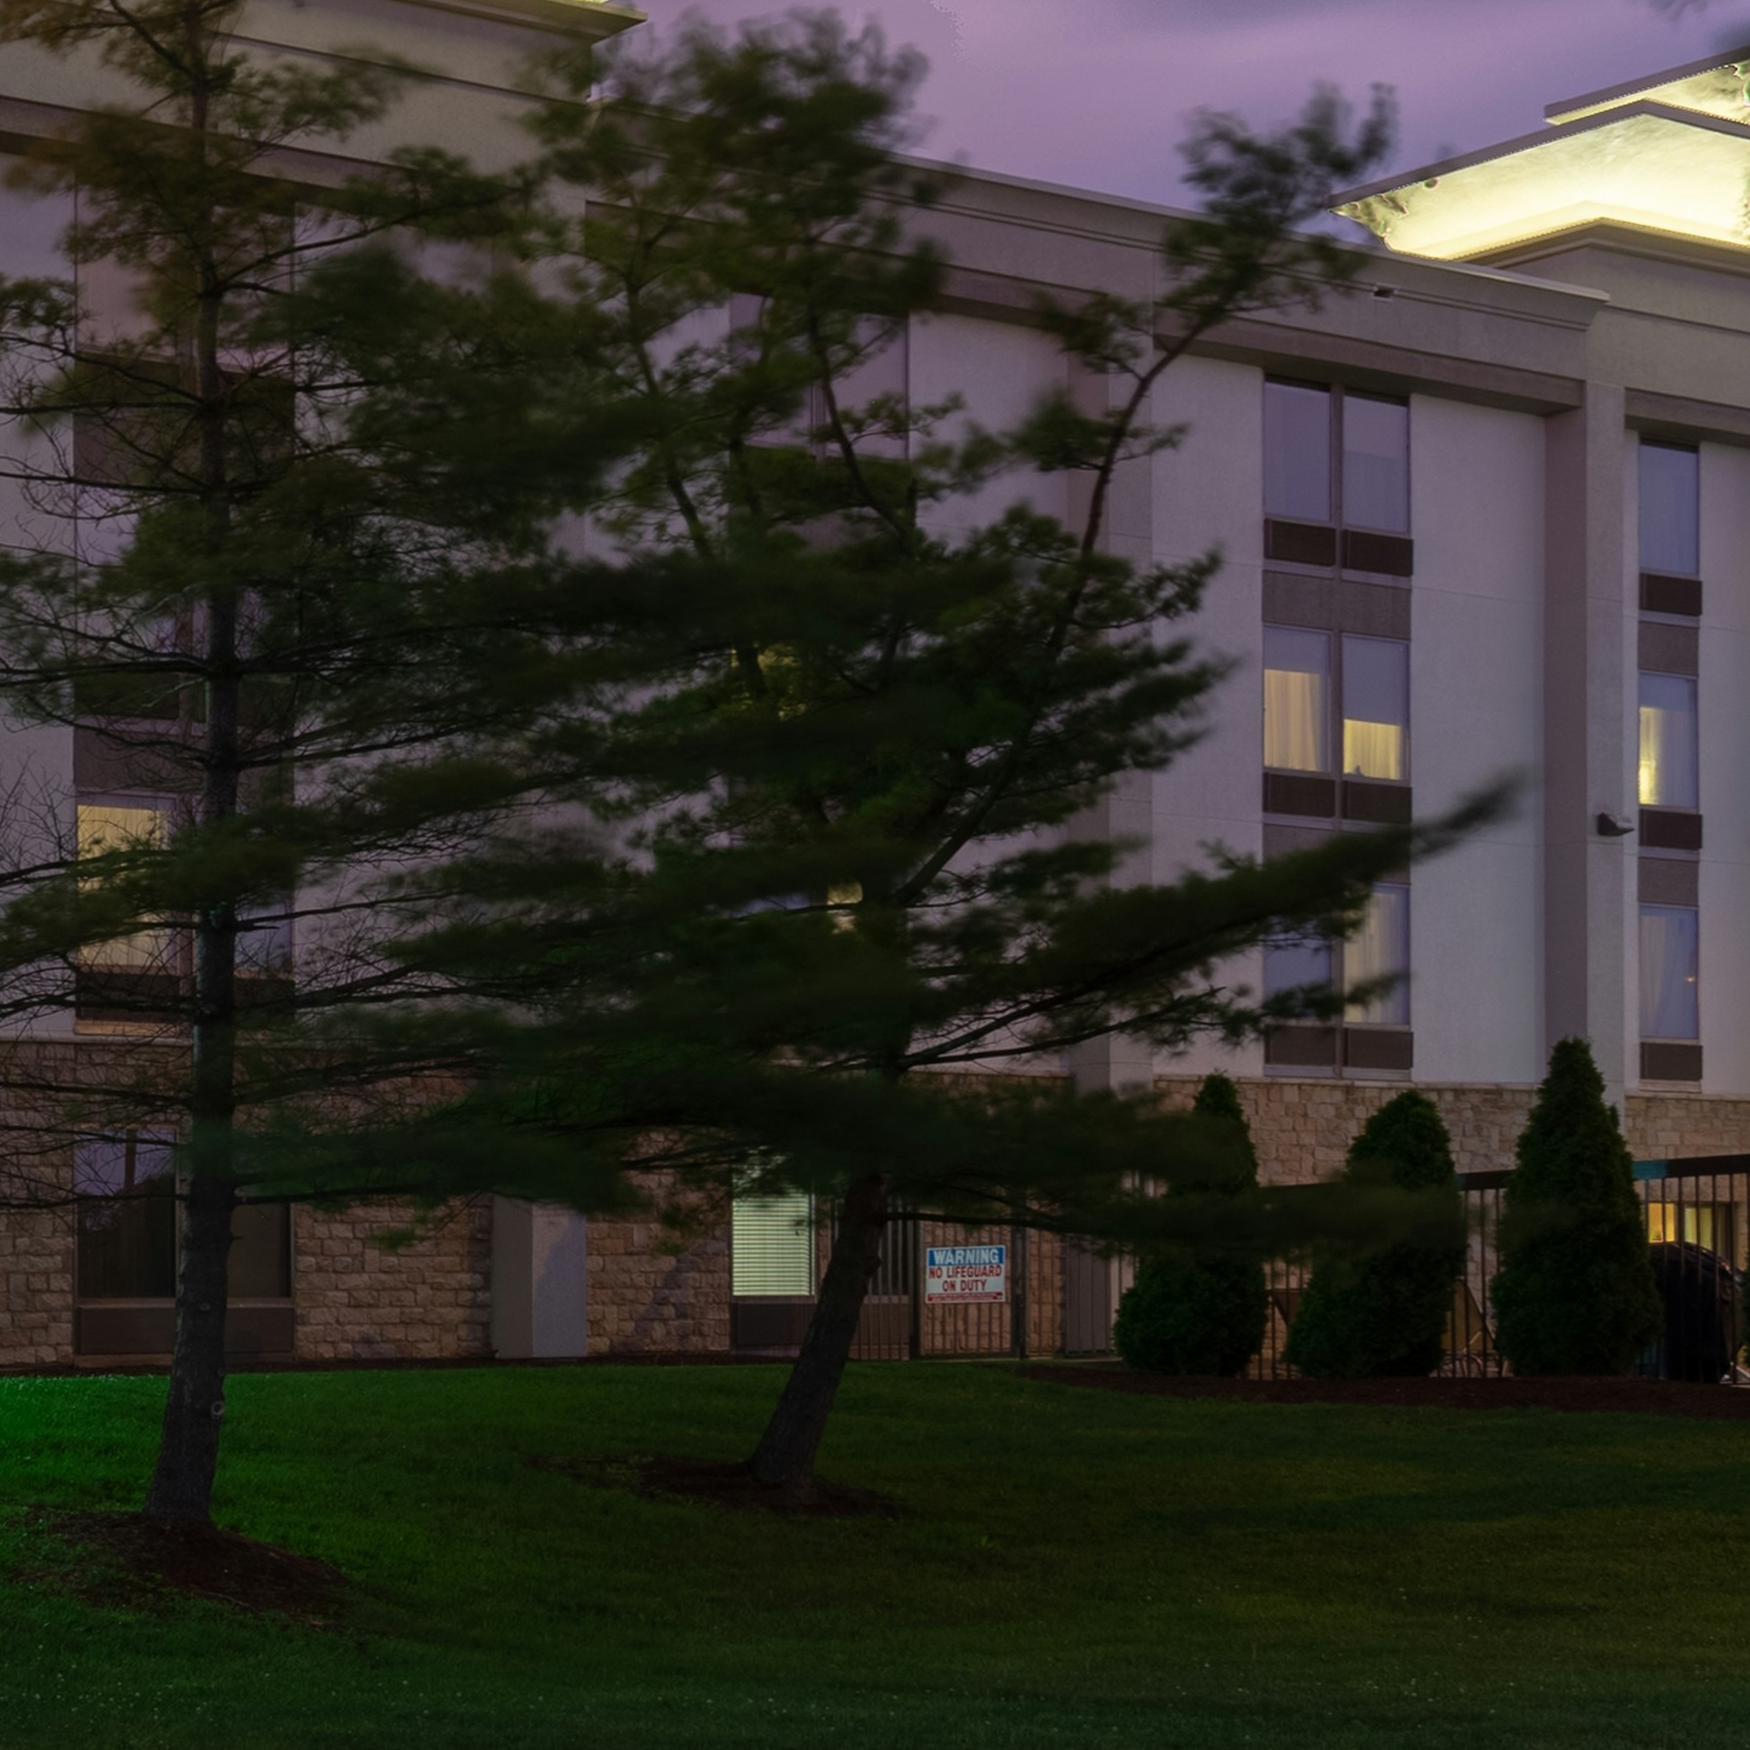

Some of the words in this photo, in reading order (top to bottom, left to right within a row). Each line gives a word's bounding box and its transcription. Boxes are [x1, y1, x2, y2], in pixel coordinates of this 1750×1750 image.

[934, 1249, 999, 1264] WARNING
[928, 1267, 942, 1278] NO
[947, 1265, 1002, 1278] LIFEGUARD
[942, 1280, 956, 1291] ON
[961, 1279, 987, 1291] DUTY
